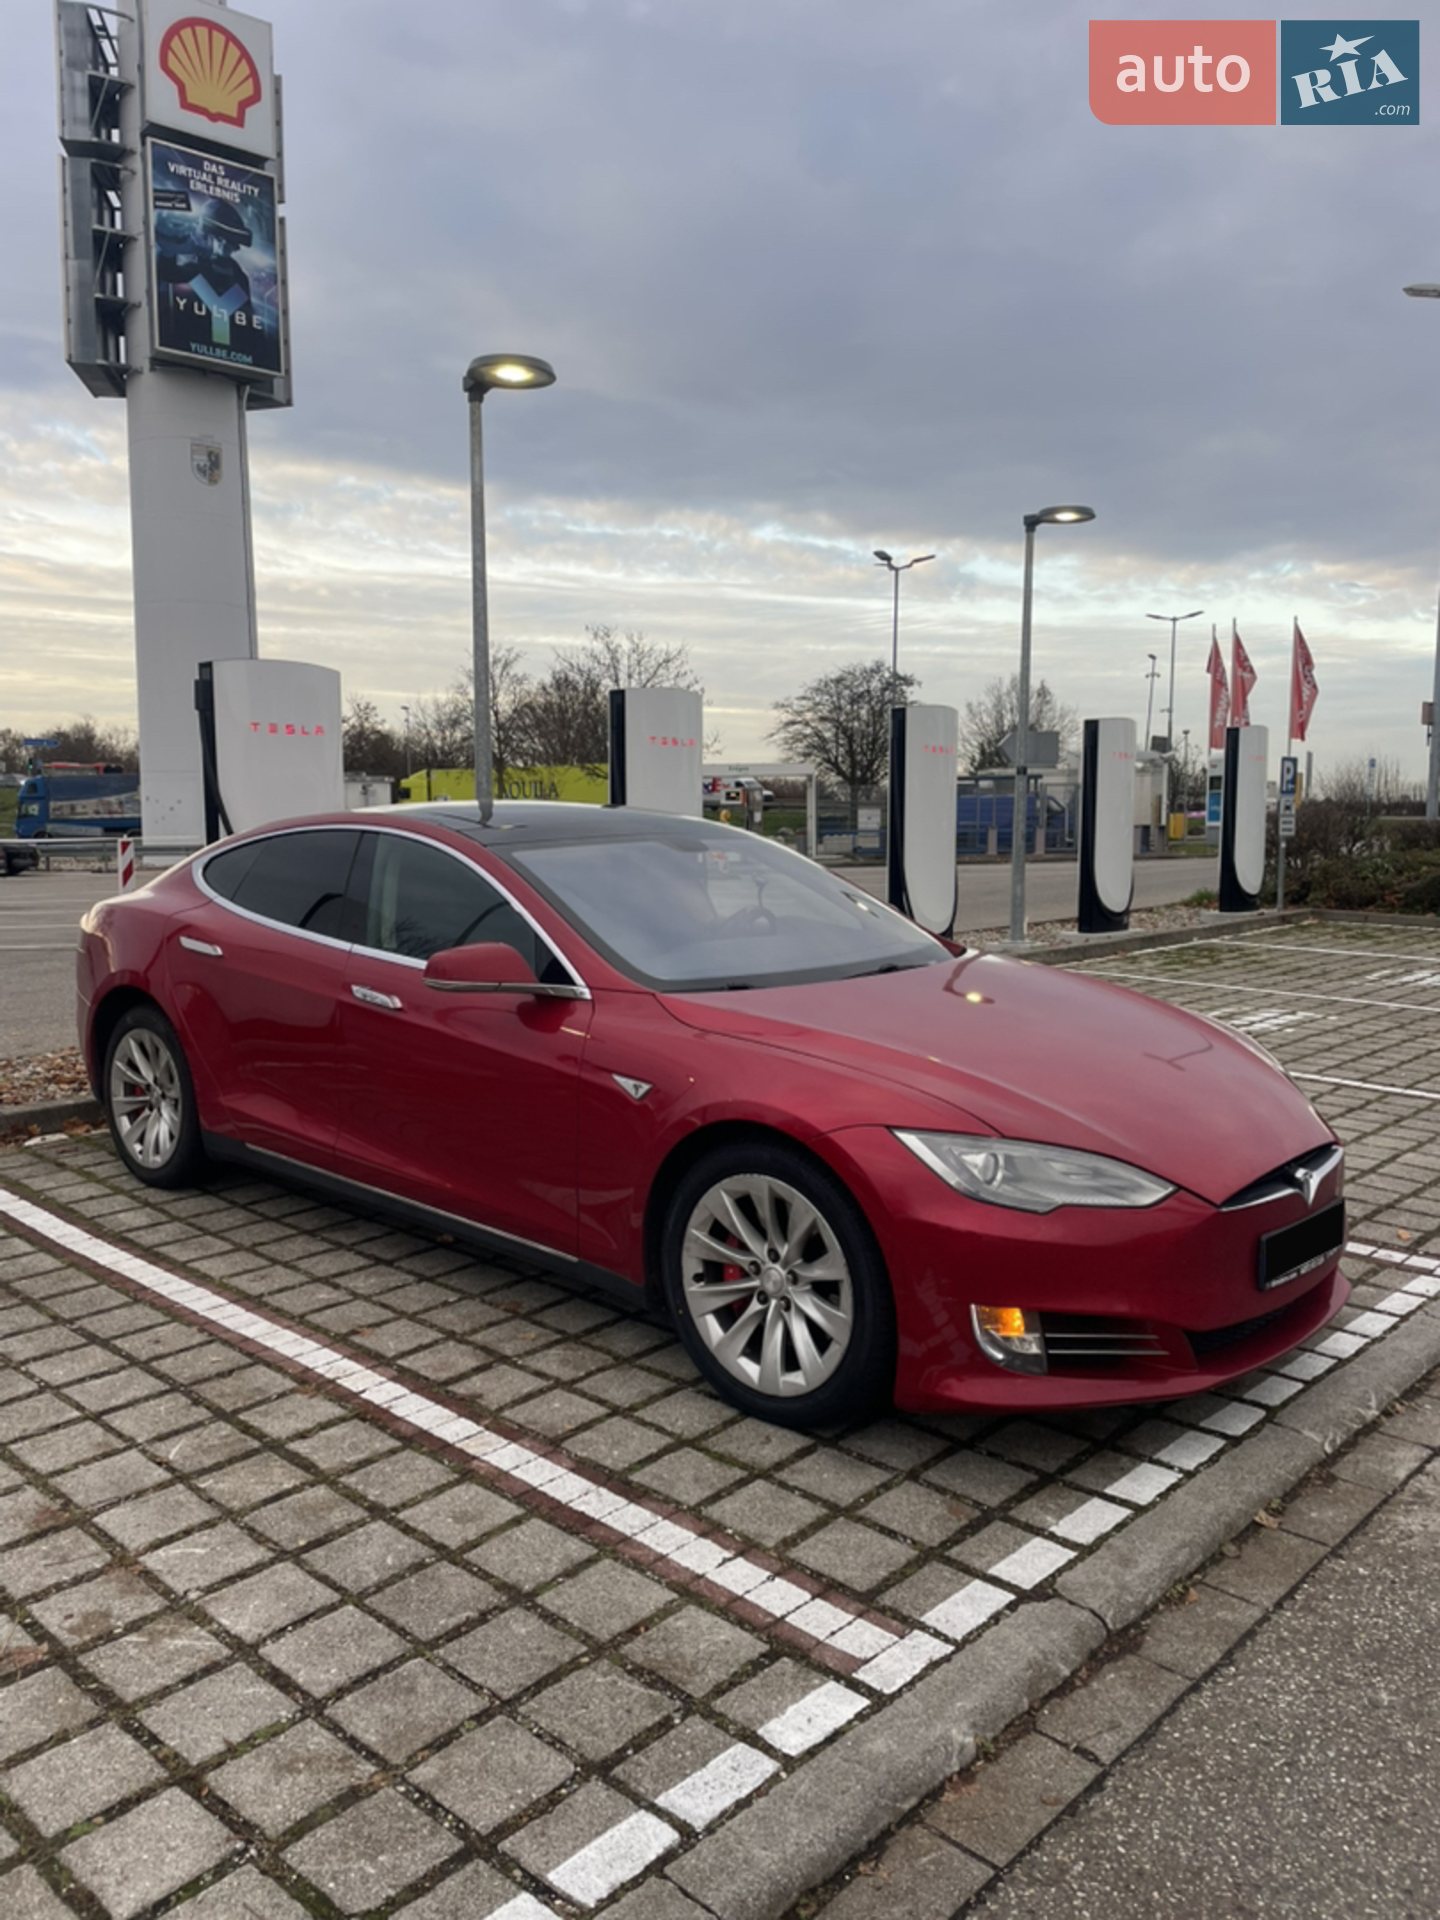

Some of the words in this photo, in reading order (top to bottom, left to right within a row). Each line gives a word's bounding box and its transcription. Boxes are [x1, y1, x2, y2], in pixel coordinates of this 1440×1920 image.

[203, 160, 225, 176] DAS
[167, 161, 215, 185] VIRTUAL
[216, 176, 260, 197] REALITY
[189, 179, 241, 204] ERLEBNIS
[190, 341, 253, 365] YULLBE.COM
[249, 722, 326, 736] TESLA
[648, 735, 697, 747] TESLA
